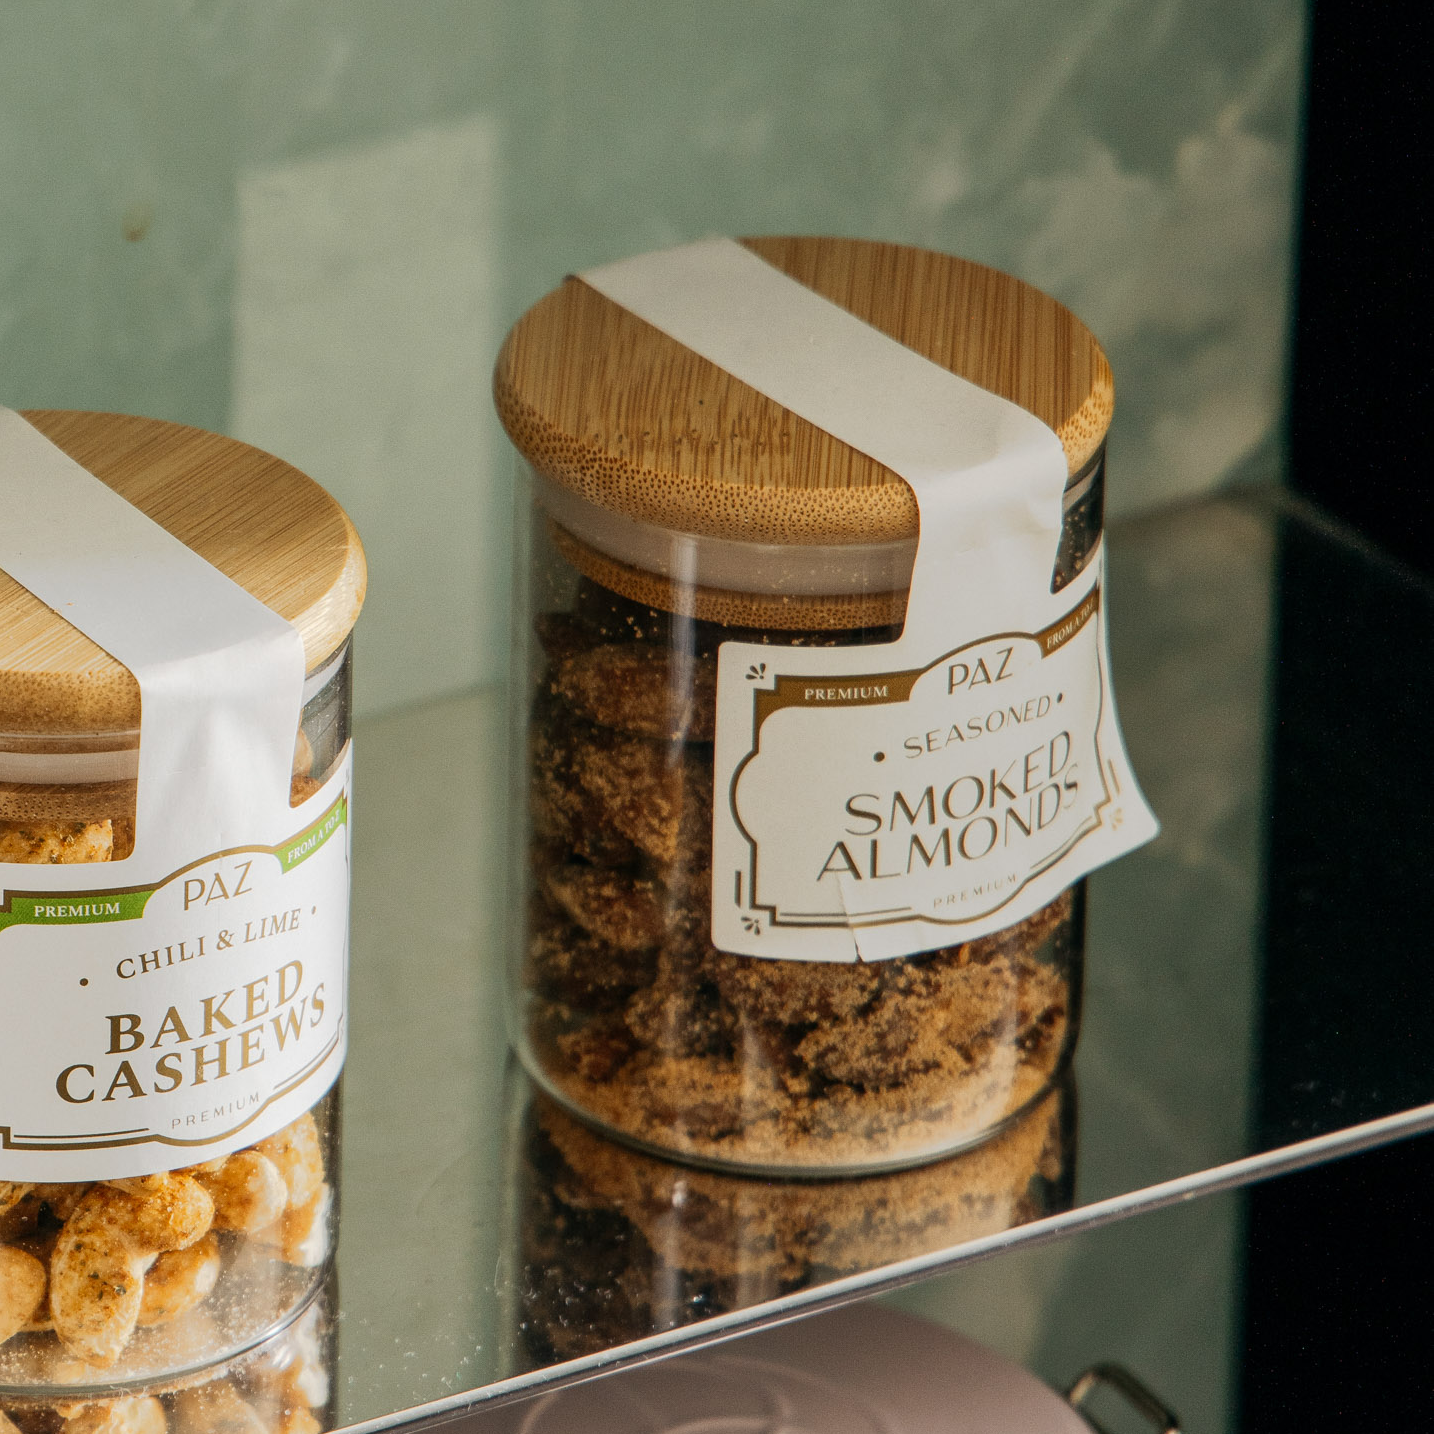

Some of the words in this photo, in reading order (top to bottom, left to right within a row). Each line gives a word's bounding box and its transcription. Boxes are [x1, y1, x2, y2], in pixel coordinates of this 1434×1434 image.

[1046, 622, 1073, 649] FROM
[804, 685, 888, 700] PREMIUM
[946, 646, 1015, 696] PAZ
[903, 694, 1051, 760] SEASONED
[844, 730, 1072, 837] SMOKED
[816, 763, 1080, 882] ALMONDS
[286, 834, 316, 864] FROM
[34, 901, 121, 918] PREMIUM
[183, 859, 254, 911] PAZ
[933, 872, 1018, 910] PREMIUM
[116, 935, 207, 981] CHILI
[215, 929, 235, 951] &
[242, 907, 302, 944] LIME
[105, 958, 304, 1056] BAKED
[55, 981, 327, 1105] CASHEWS
[170, 1090, 261, 1130] PREMIUM
